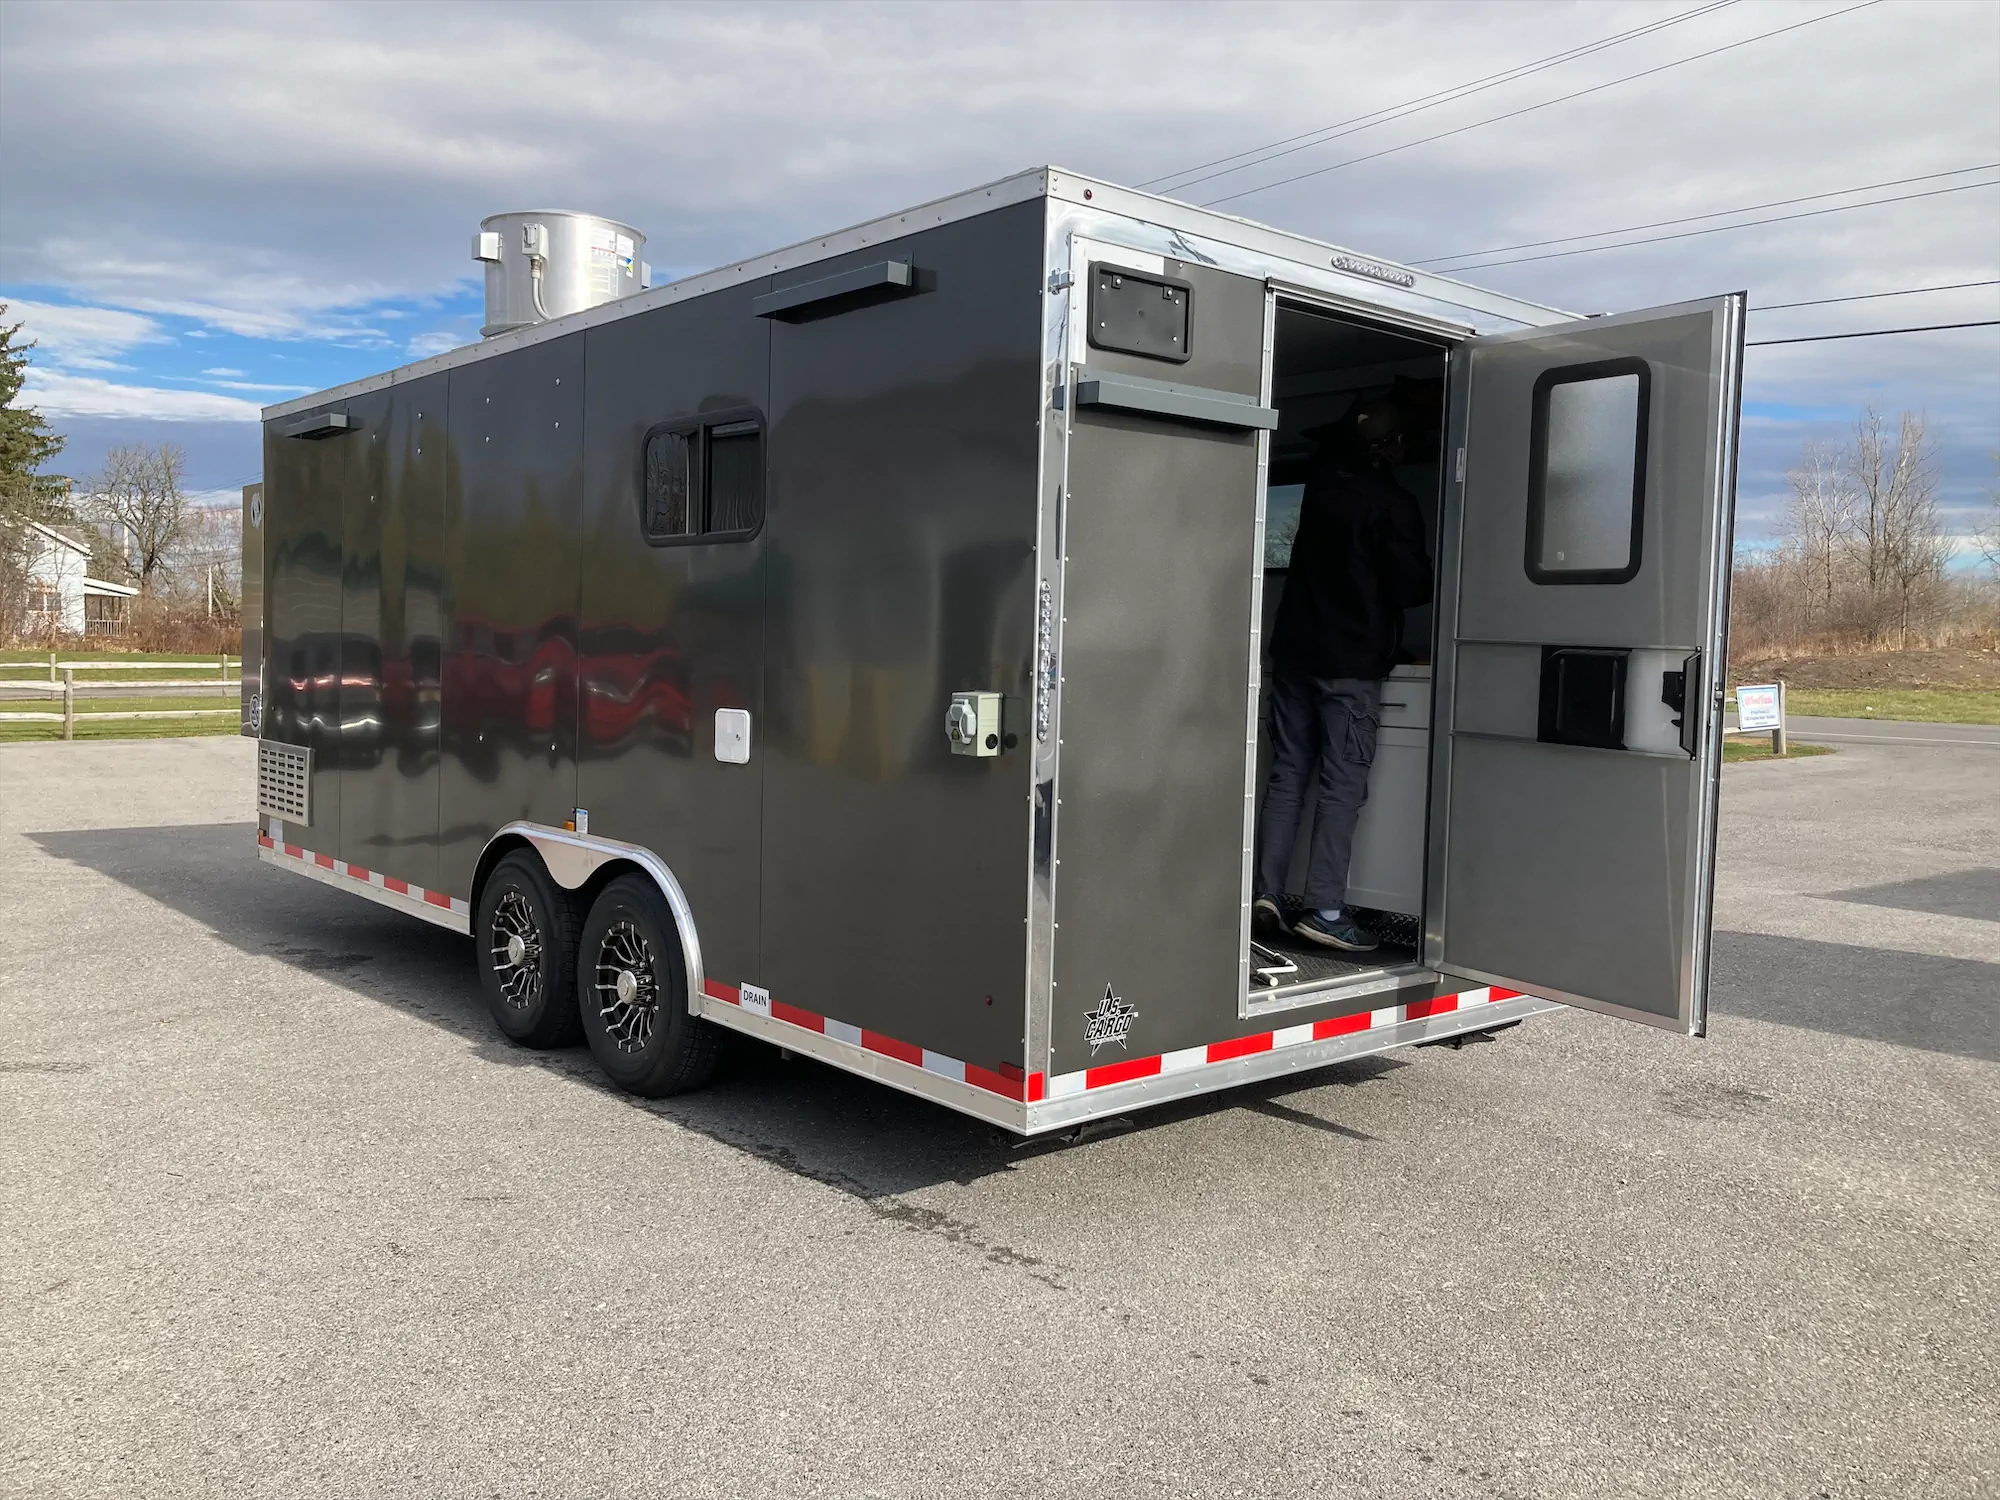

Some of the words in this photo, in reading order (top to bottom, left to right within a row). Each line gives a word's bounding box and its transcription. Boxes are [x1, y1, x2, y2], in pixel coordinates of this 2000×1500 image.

[743, 990, 767, 1007] DRAIN
[1097, 997, 1121, 1018] U.S.
[1084, 1013, 1133, 1040] CARGO
